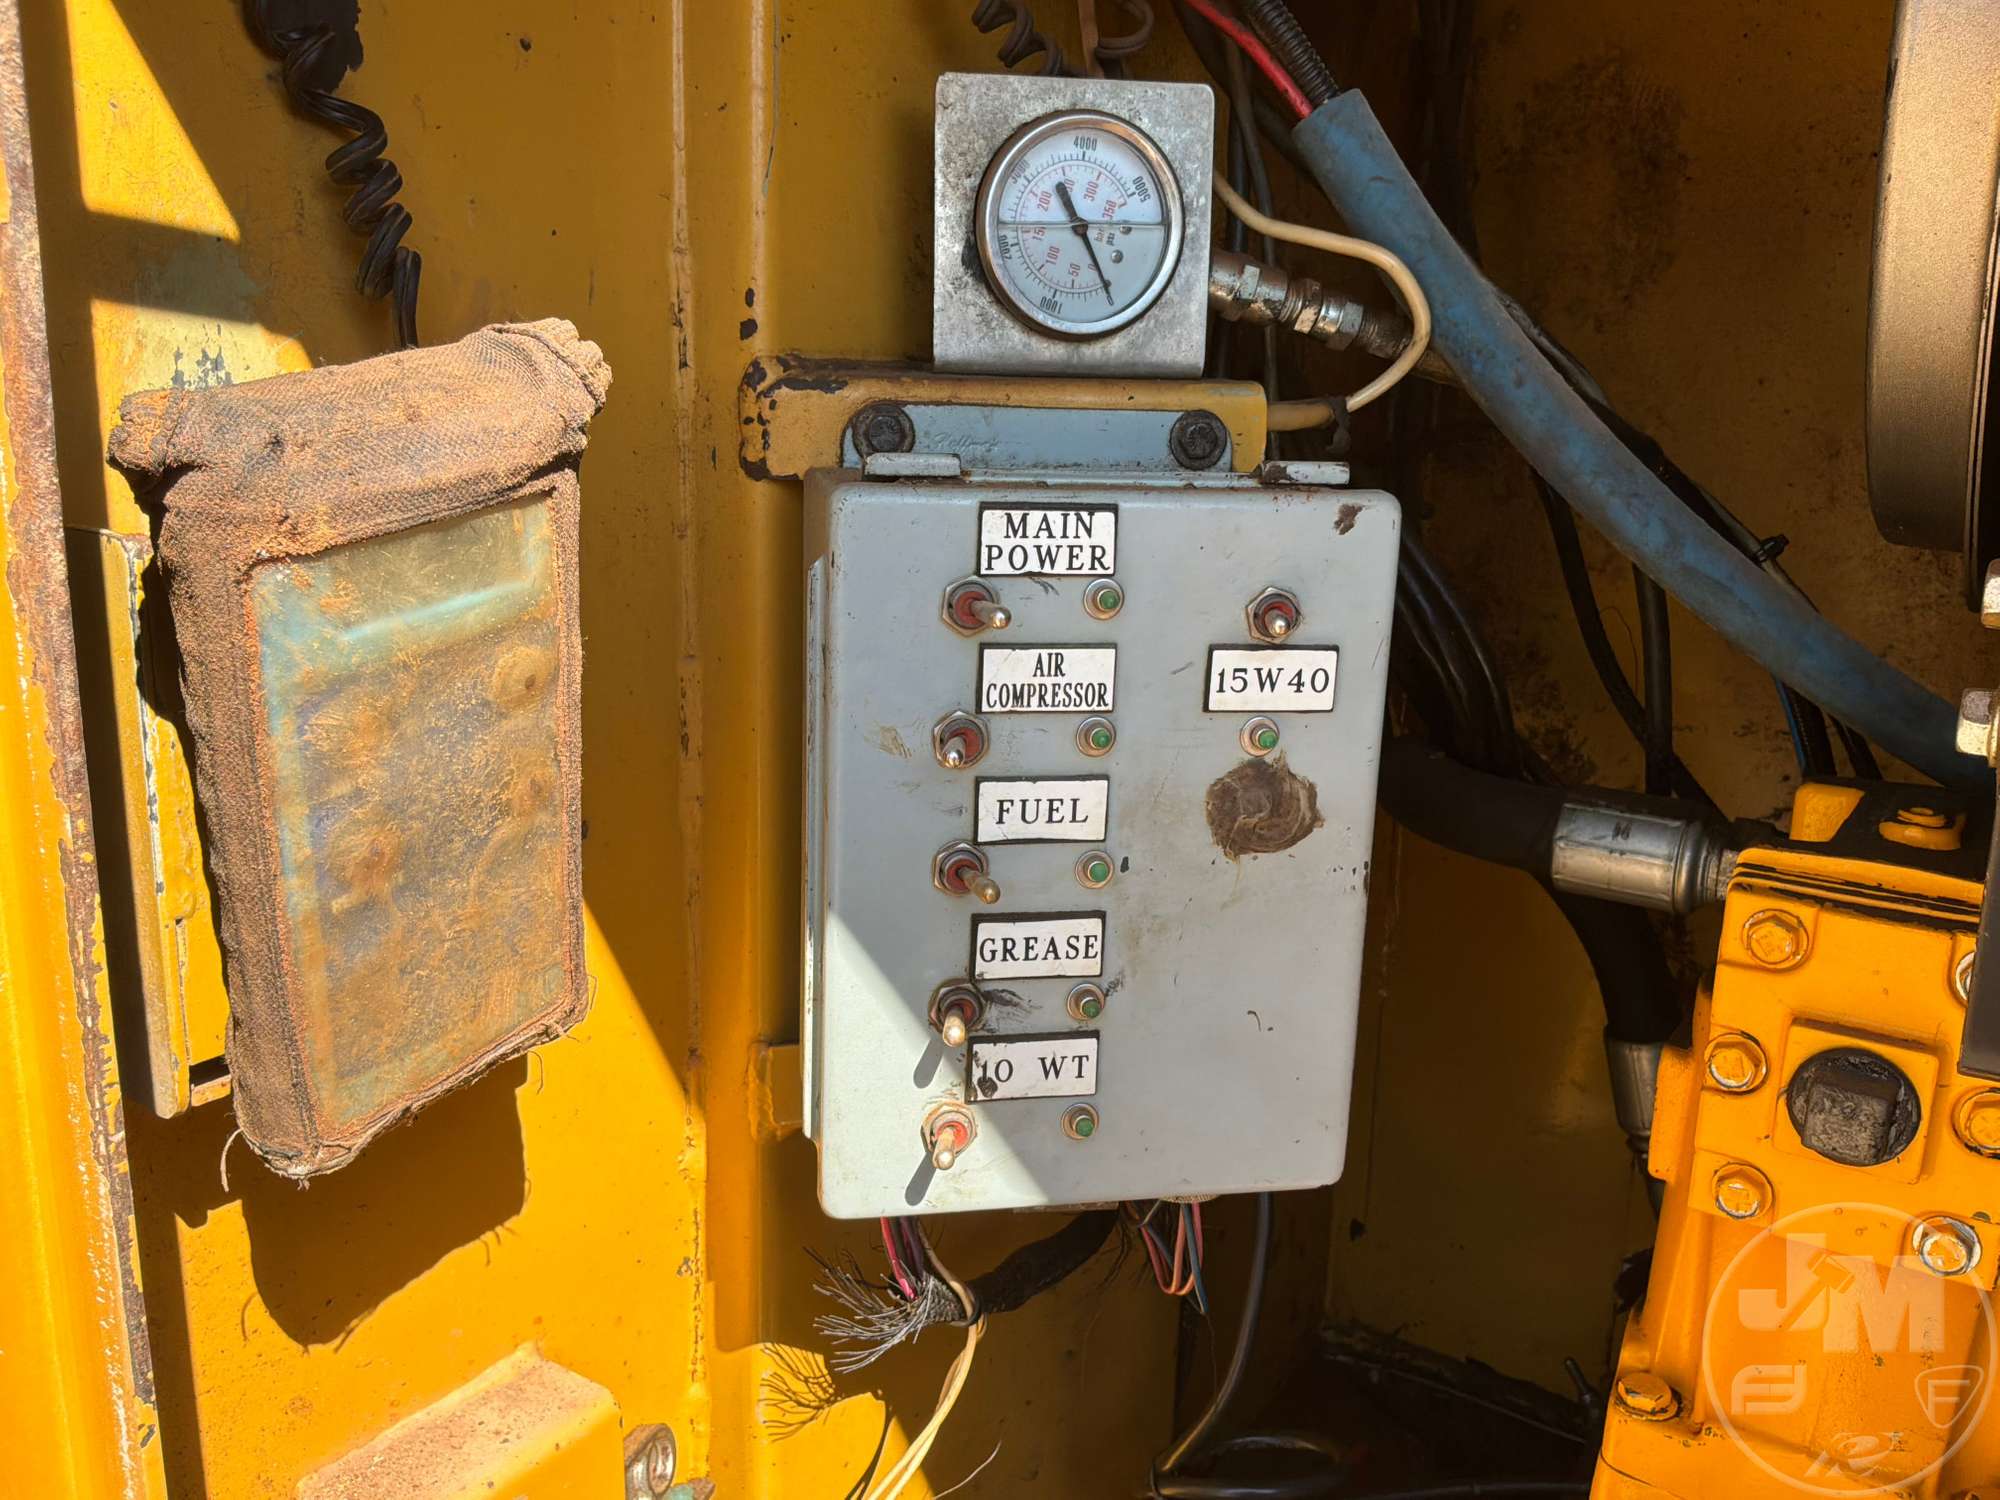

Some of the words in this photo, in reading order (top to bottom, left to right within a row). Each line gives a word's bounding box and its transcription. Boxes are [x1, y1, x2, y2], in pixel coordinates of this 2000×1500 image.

[1073, 135, 1098, 151] 4000
[1037, 190, 1053, 212] 200
[1083, 180, 1099, 202] 300
[1132, 175, 1151, 203] 5000
[1102, 199, 1118, 221] 350
[1000, 234, 1013, 260] 2000
[1046, 246, 1060, 265] 100
[1068, 263, 1081, 277] 50
[1040, 296, 1063, 315] 1000
[1003, 512, 1096, 540] MAIN
[984, 544, 1111, 572] POWER
[1032, 652, 1066, 678] AIR
[1215, 667, 1331, 695] 15W40
[986, 682, 1109, 708] COMPRESSOR
[995, 798, 1089, 825] FUEL
[979, 934, 1099, 963] GREASE
[981, 1058, 1014, 1083] 10
[1037, 1054, 1090, 1080] WT
